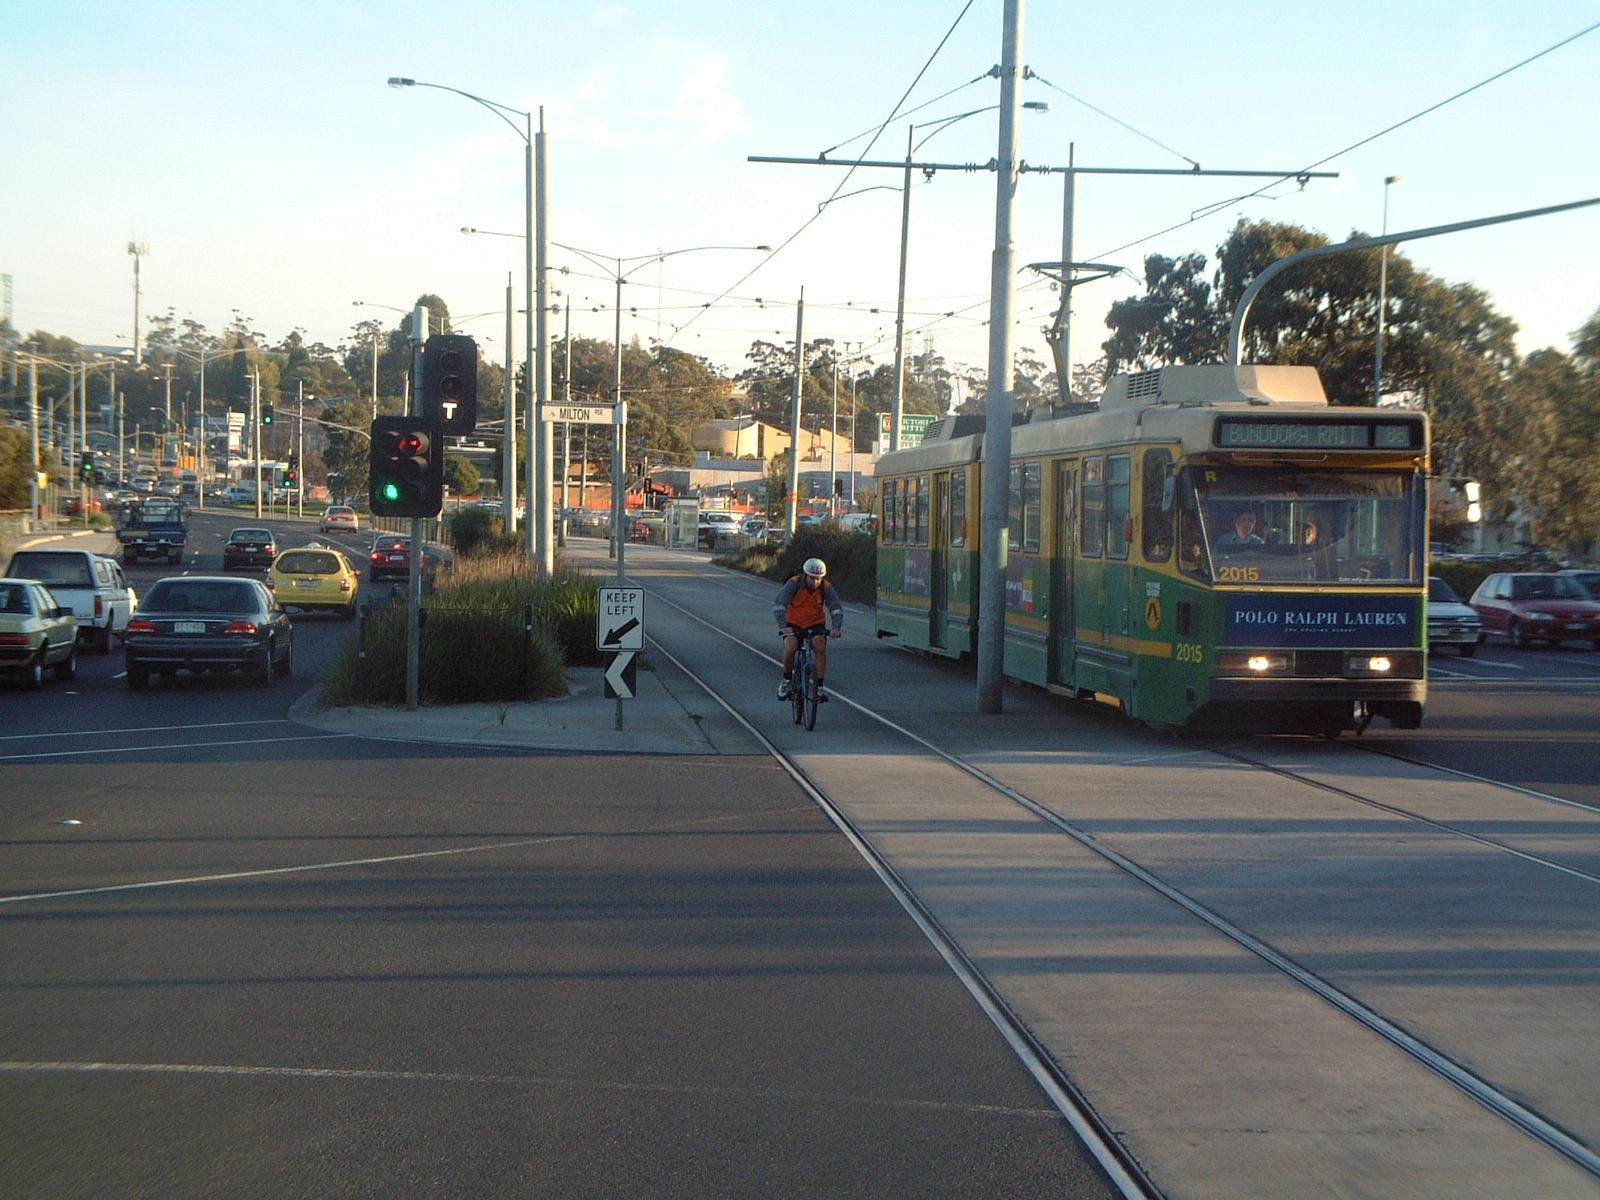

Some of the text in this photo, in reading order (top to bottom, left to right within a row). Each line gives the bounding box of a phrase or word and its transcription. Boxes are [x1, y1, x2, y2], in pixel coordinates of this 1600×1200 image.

[559, 407, 590, 421] MILTON
[1229, 424, 1309, 443] BUNDOORA
[1317, 425, 1357, 443] RMIT
[1219, 566, 1260, 581] 2015
[606, 592, 637, 603] KEEP
[607, 605, 635, 616] LEFT
[1234, 610, 1408, 626] POLO RALPH LAUREN
[1176, 642, 1203, 664] 2015
